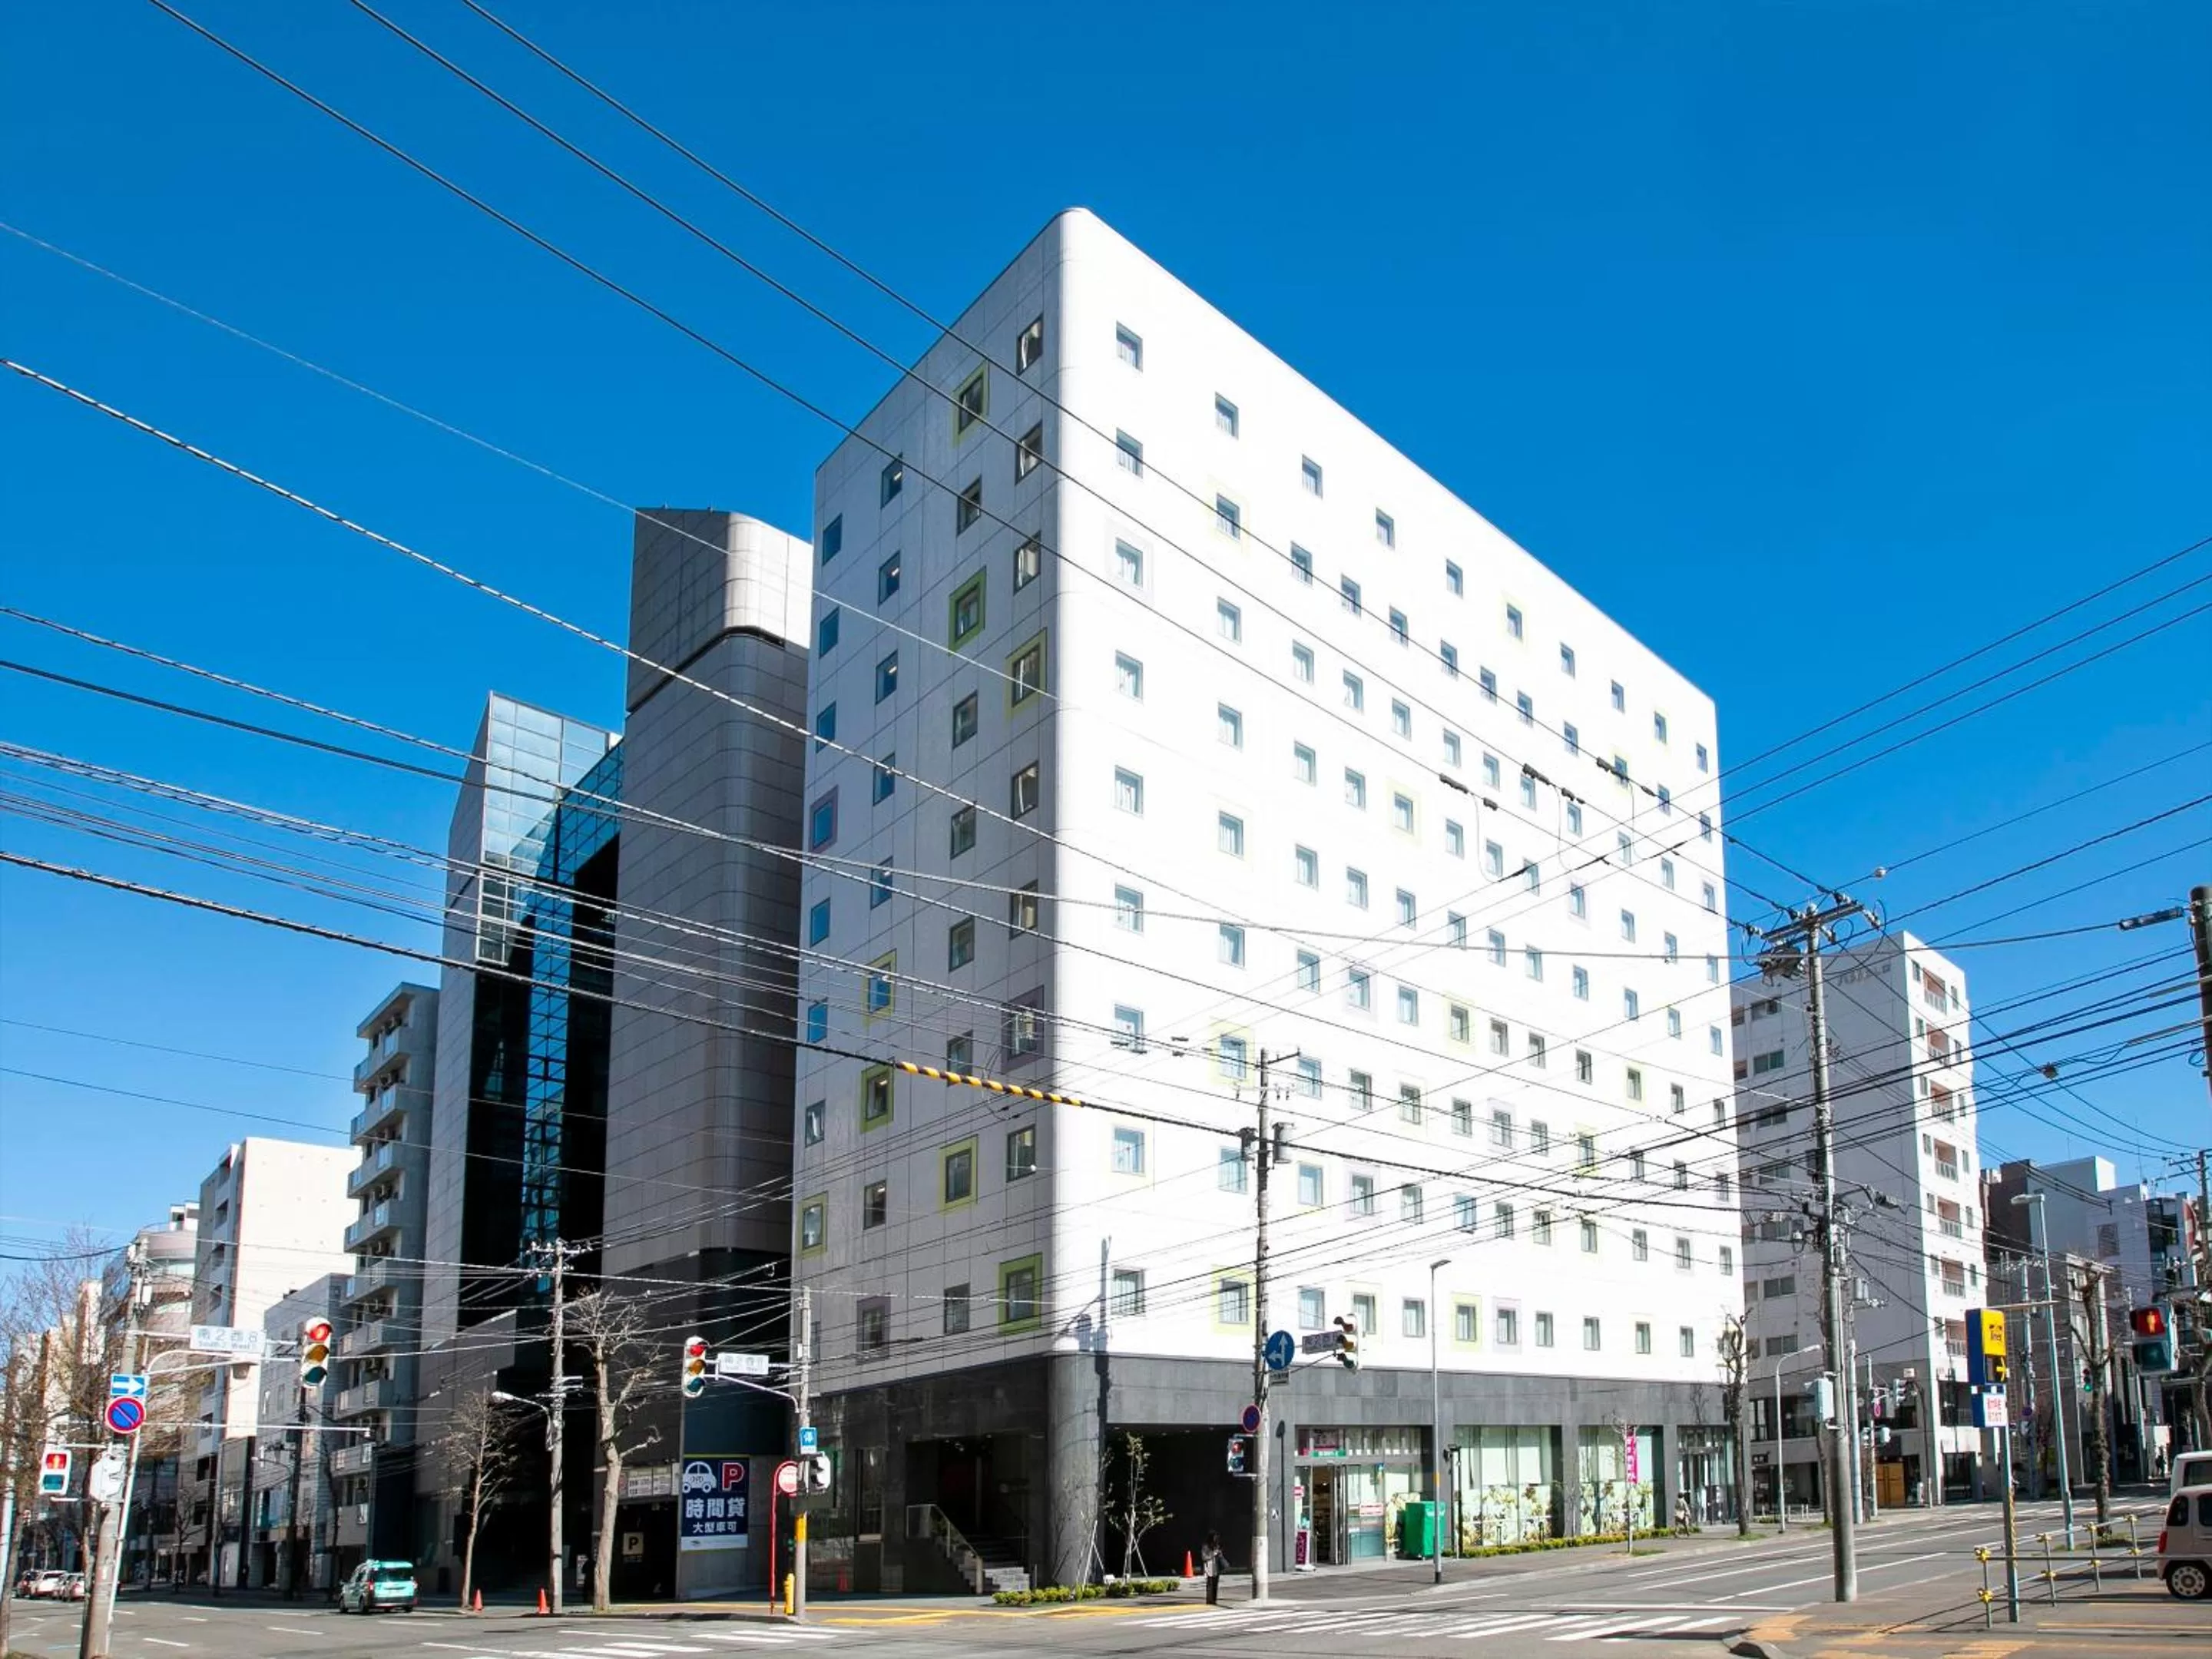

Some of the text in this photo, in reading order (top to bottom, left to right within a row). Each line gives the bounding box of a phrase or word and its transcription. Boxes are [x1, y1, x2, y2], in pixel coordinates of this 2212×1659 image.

[722, 1462, 745, 1492] P
[685, 1498, 746, 1518] 時間貸
[692, 1522, 737, 1534] 大型車可
[628, 1537, 639, 1550] P
